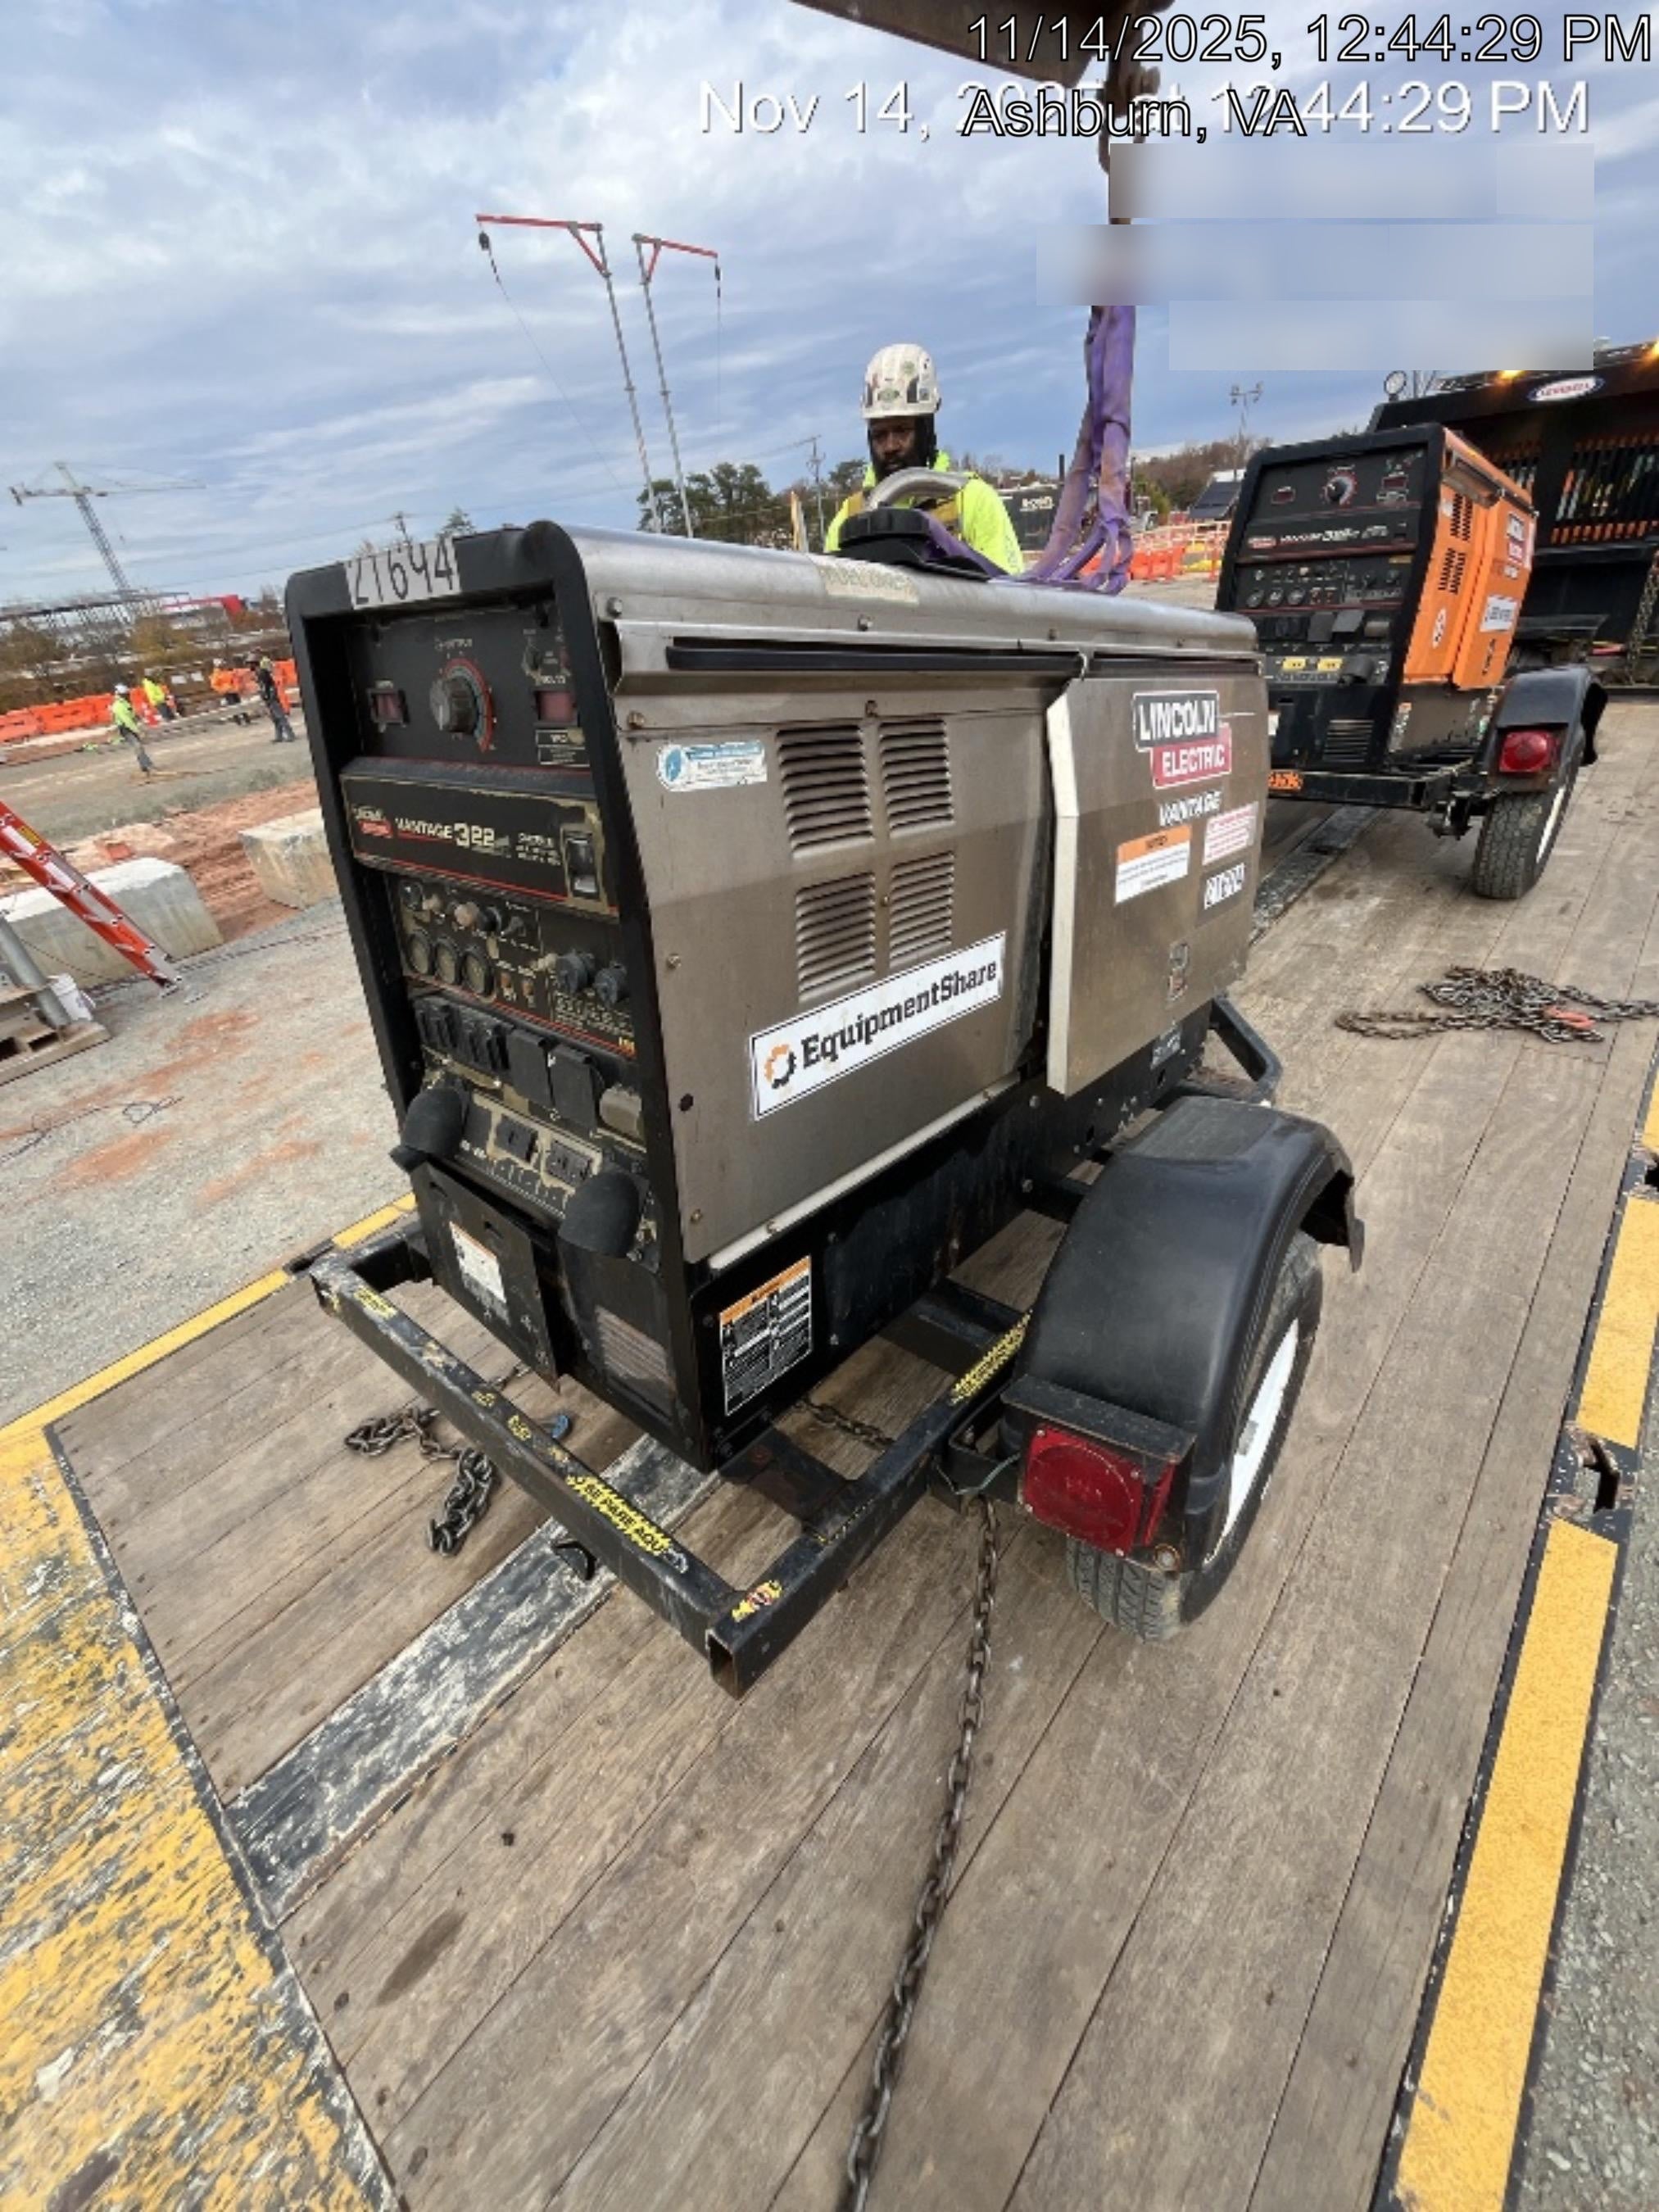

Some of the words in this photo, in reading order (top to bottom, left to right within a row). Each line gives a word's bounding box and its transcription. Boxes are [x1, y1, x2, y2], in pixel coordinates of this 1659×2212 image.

[1139, 700, 1216, 741] LINCOLN
[1162, 744, 1226, 778] ELECTRIC
[800, 960, 997, 1069] EquipmentShare
